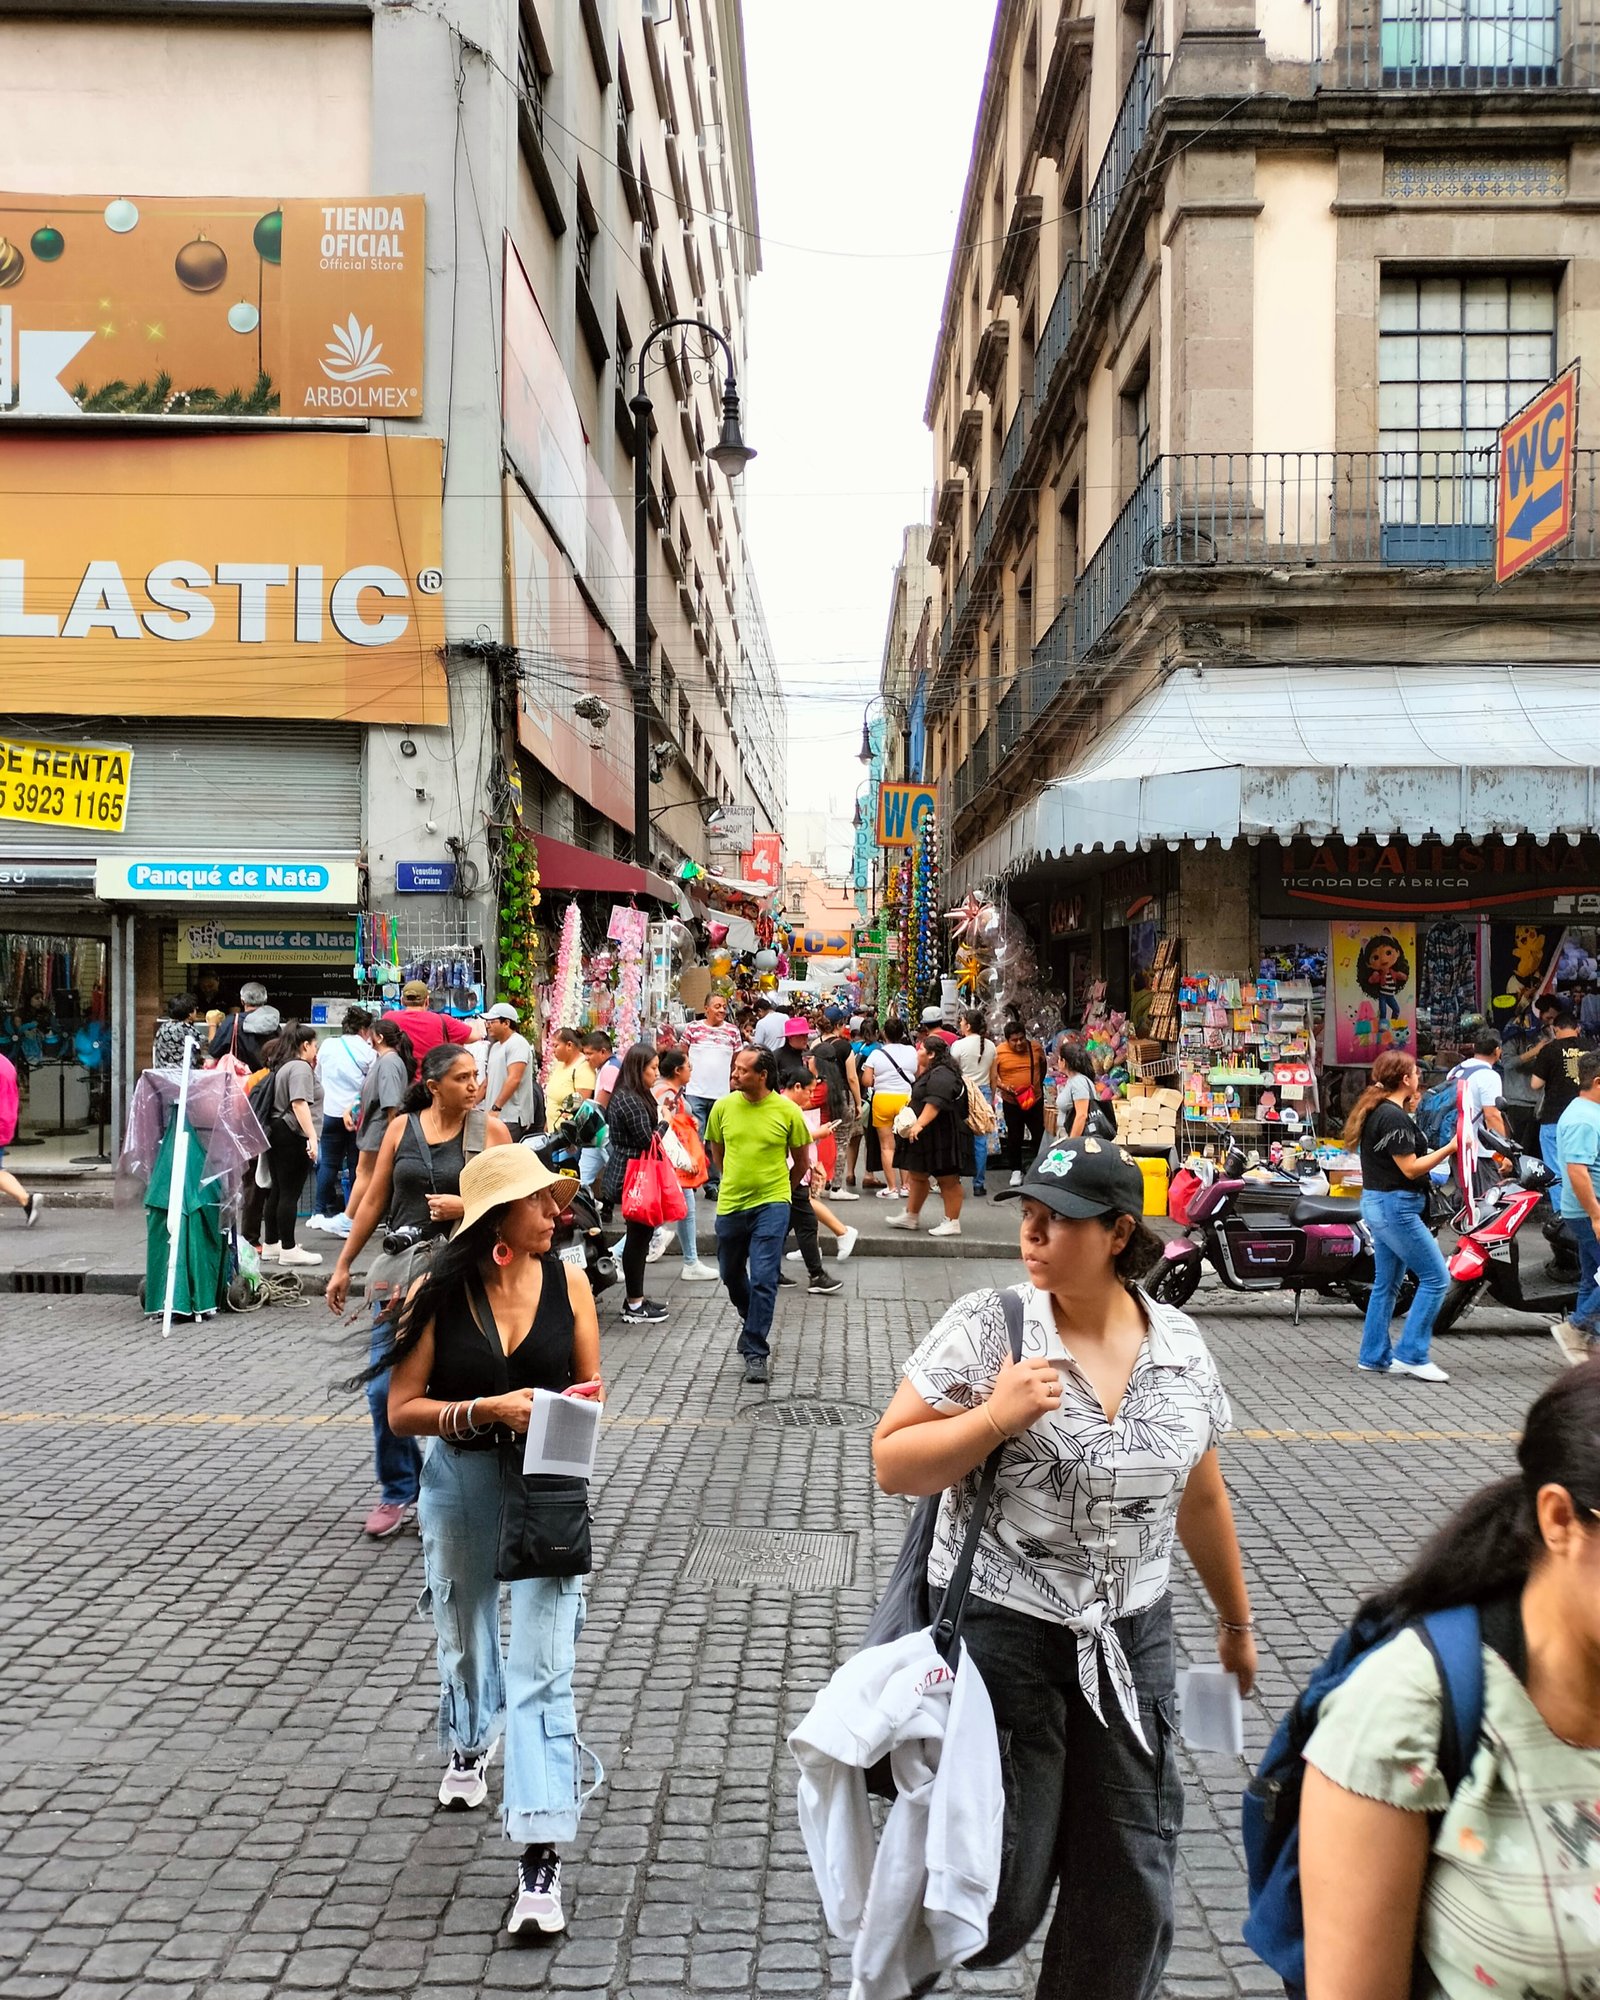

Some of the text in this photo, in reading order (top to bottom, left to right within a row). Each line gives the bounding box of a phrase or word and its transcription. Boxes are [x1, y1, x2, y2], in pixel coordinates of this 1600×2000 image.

[322, 206, 404, 231] TIENDA
[320, 233, 404, 257] OFICIAL
[319, 258, 404, 270] Official Store
[1506, 402, 1566, 500] WC
[32, 748, 125, 785] RENTA
[13, 781, 65, 816] 3923
[74, 789, 124, 823] 1165
[884, 790, 936, 839] WC
[752, 849, 771, 874] 4
[1281, 846, 1588, 874] LA PALESTINA
[136, 865, 322, 890] Panqué de Nata
[413, 876, 441, 885] Carranza
[1281, 875, 1470, 888] TIENDA DE FÁBRICA
[224, 931, 355, 949] Panqué de Nata
[312, 952, 343, 962] Sabor!
